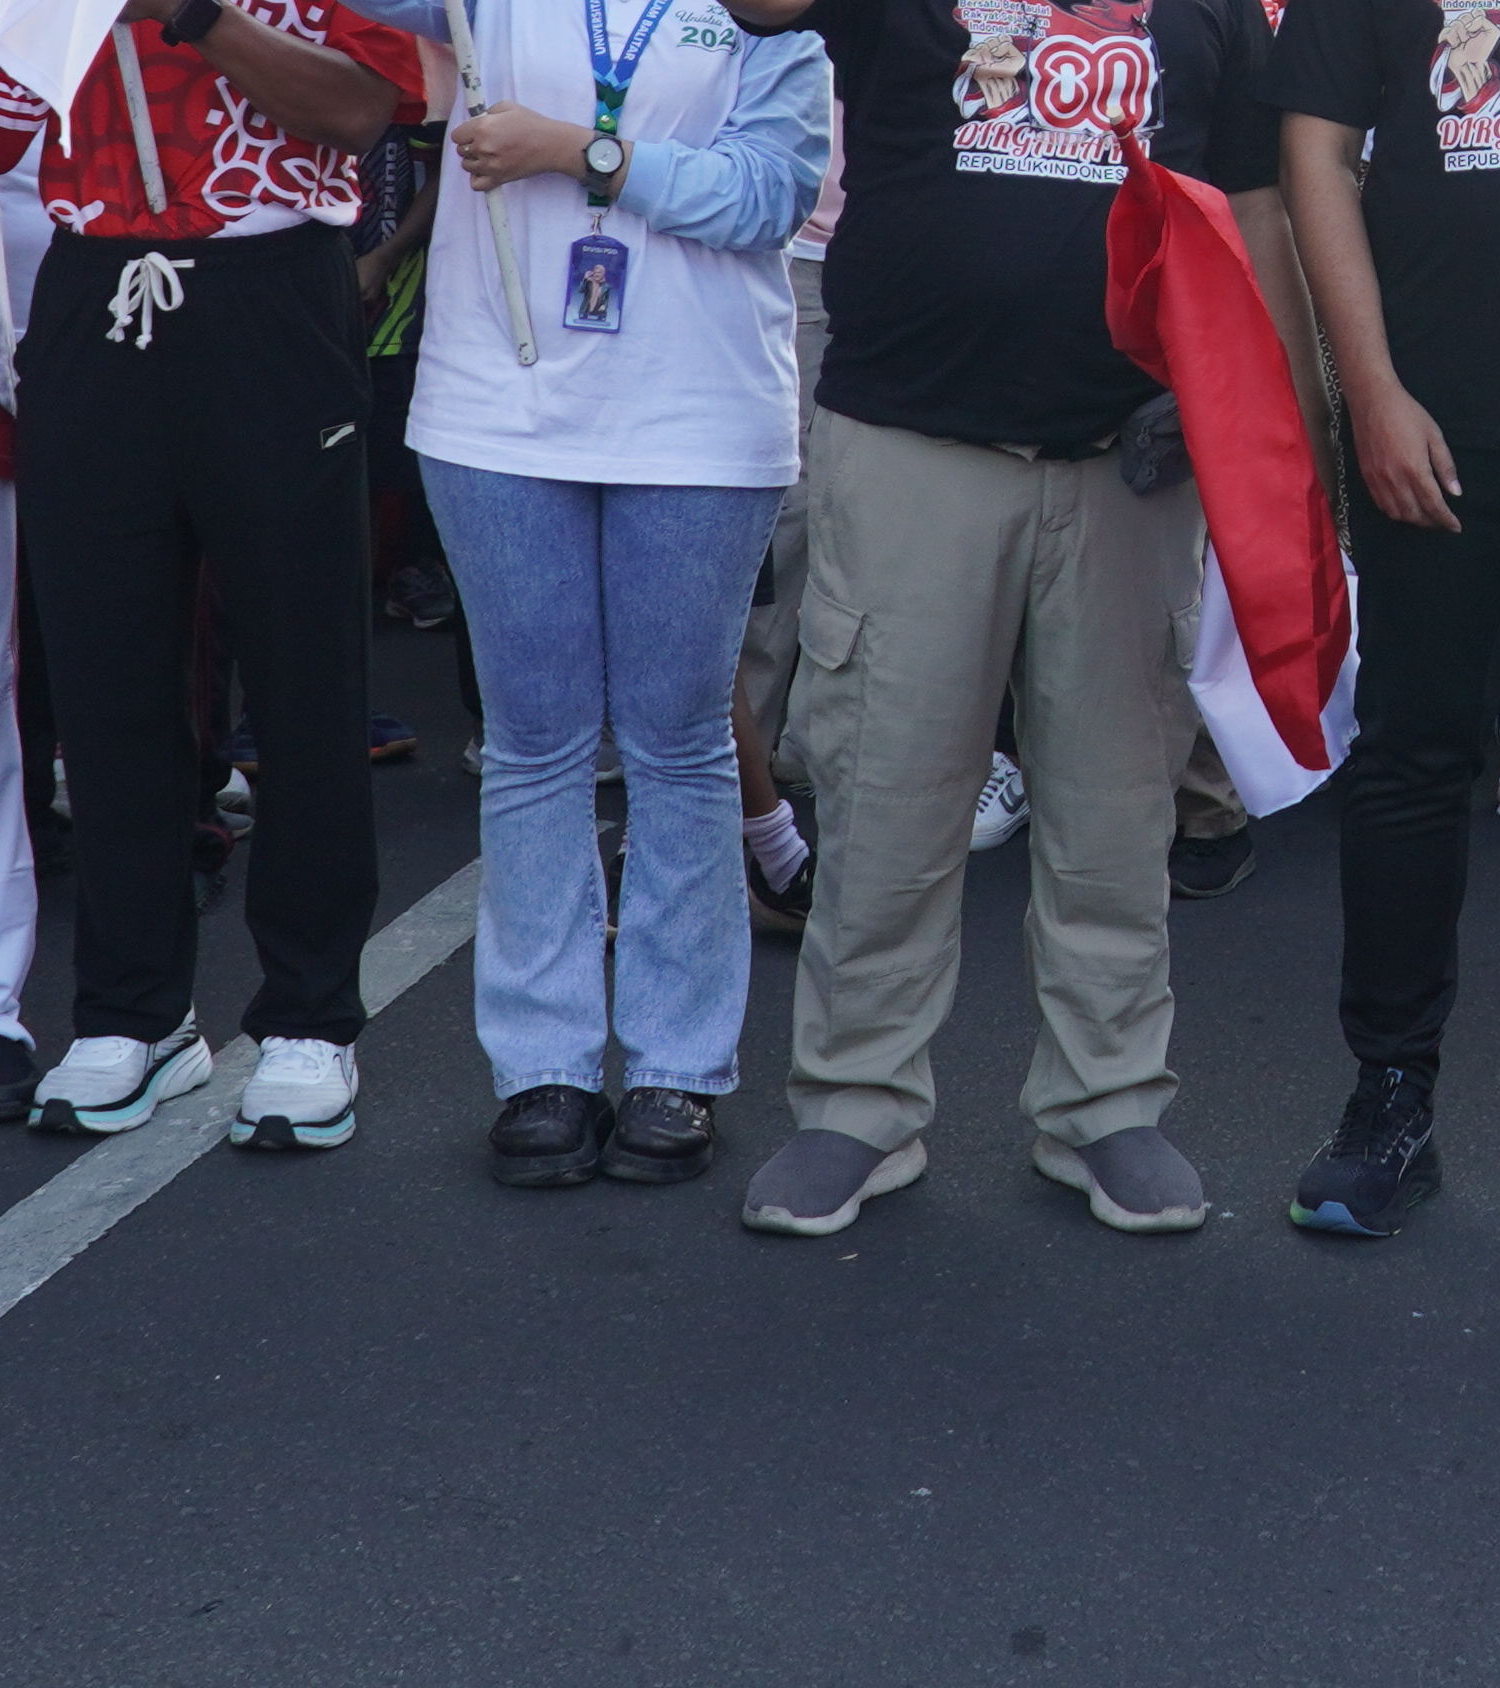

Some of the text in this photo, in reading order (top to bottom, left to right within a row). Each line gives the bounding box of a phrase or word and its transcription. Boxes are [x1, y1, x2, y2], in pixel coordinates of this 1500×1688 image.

[963, 11, 1001, 23] Rakyat
[968, 22, 1020, 35] Indonesia
[623, 19, 655, 62] BALITAR
[1033, 39, 1153, 134] 80
[958, 154, 1126, 182] REPUBLIK INDONES
